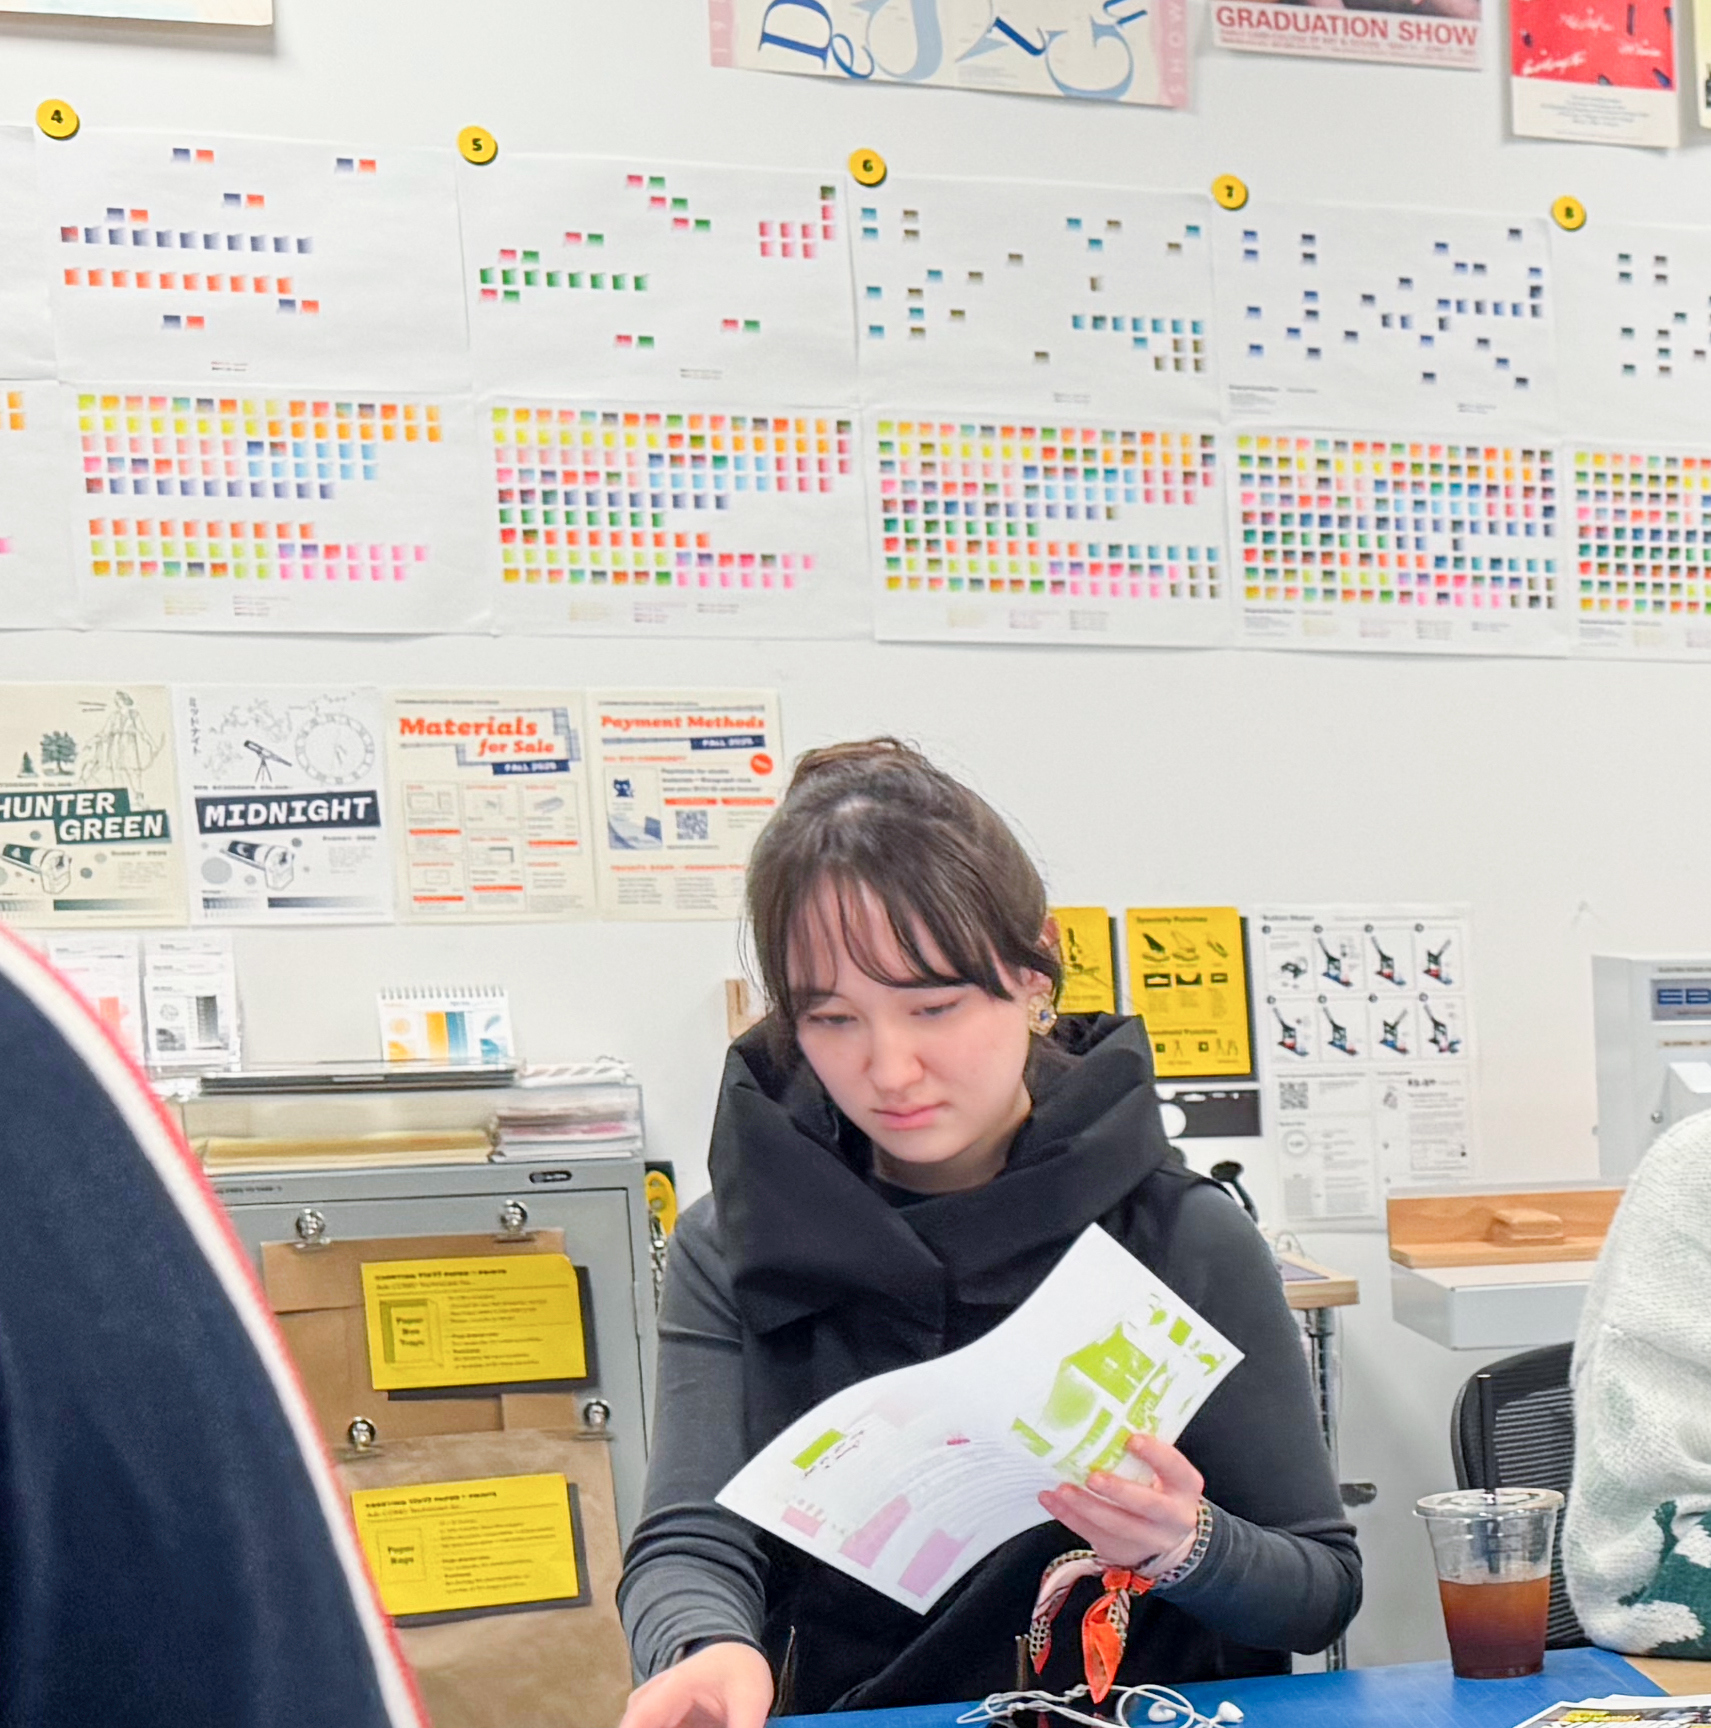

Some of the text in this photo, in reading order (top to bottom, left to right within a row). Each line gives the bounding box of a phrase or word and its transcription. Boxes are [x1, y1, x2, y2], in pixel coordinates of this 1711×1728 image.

[1216, 8, 1389, 41] GRADUATION
[1398, 21, 1479, 47] SHOW
[399, 716, 538, 736] Materials
[601, 715, 766, 732] Payment Methods
[477, 738, 555, 757] for Sale
[204, 796, 373, 829] MIDNIGHT
[59, 814, 163, 842] GREEN
